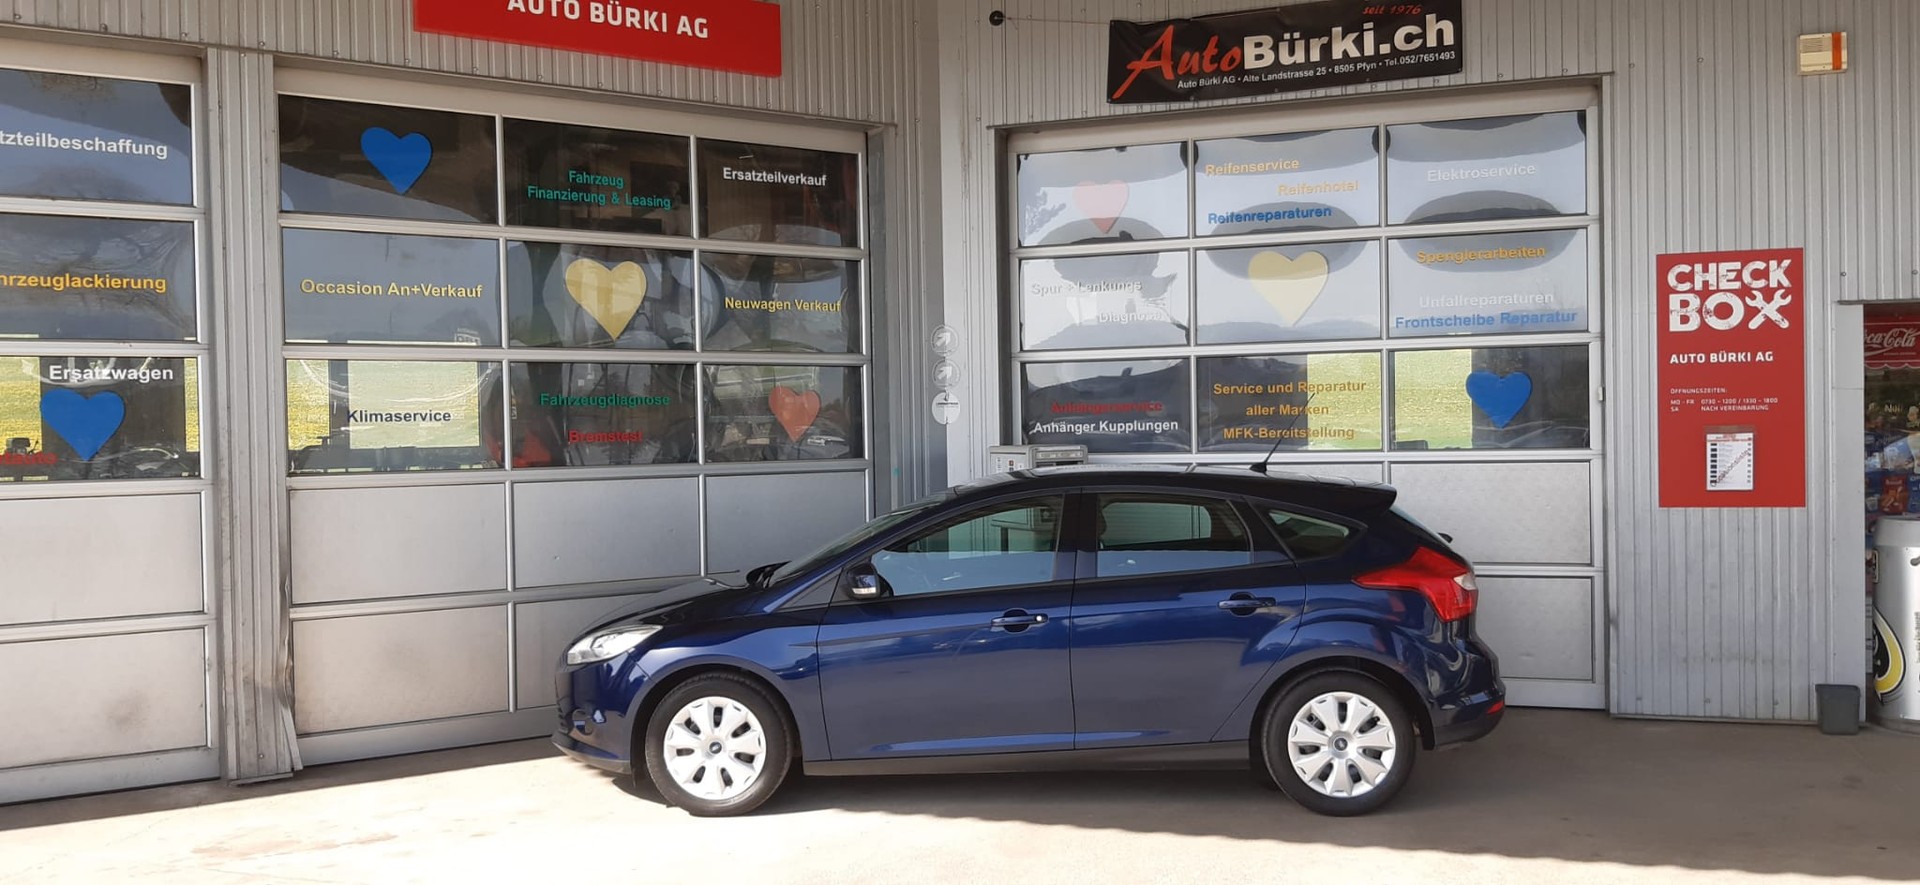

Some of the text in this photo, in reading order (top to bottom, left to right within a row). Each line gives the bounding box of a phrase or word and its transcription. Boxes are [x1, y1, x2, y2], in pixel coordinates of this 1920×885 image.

[1362, 4, 1421, 15] seit 1976
[508, 0, 709, 38] AUTO BÜRKI AG
[1177, 51, 1455, 89] Auto Bürki AG Alte Landstrasse 25 8505 Pfyn Tel.052/7651493
[1205, 159, 1300, 176] Reifenservice
[1427, 163, 1536, 182] Elektroservice
[568, 170, 624, 189] Fahrzeug
[723, 167, 827, 186] Ersatzteilverkauf
[1278, 180, 1360, 196] Reifenhotel
[527, 186, 671, 210] Finanzierung & Leasing
[1208, 206, 1332, 224] Reifenreparaturen
[1416, 247, 1546, 264] Spenglerarbeiten
[1667, 259, 1792, 291] CHECK
[301, 279, 482, 298] Occasion An+Verkauf
[1031, 282, 1062, 297] Spur
[1078, 280, 1142, 296] Lenkungs
[725, 297, 841, 312] Neuwagen Verkauf
[1419, 293, 1554, 308] Unfallreparaturen
[1669, 289, 1792, 332] BOX
[1395, 311, 1578, 329] Frontscheibe Reparatur
[1866, 327, 1920, 348] ca-Cola
[1670, 350, 1774, 364] AUTO BÜRKI AG
[49, 365, 173, 383] Ersatzwagen
[1213, 381, 1366, 394] Service und Reparatur
[540, 393, 670, 409] Fahrzeugdiagnose
[1246, 404, 1275, 415] aller
[347, 410, 451, 423] Klimaservice
[1034, 420, 1178, 435] Anhänger Kupplungen
[1223, 427, 1354, 440] MFK-Bereitstellung
[568, 430, 643, 443] Bremstest
